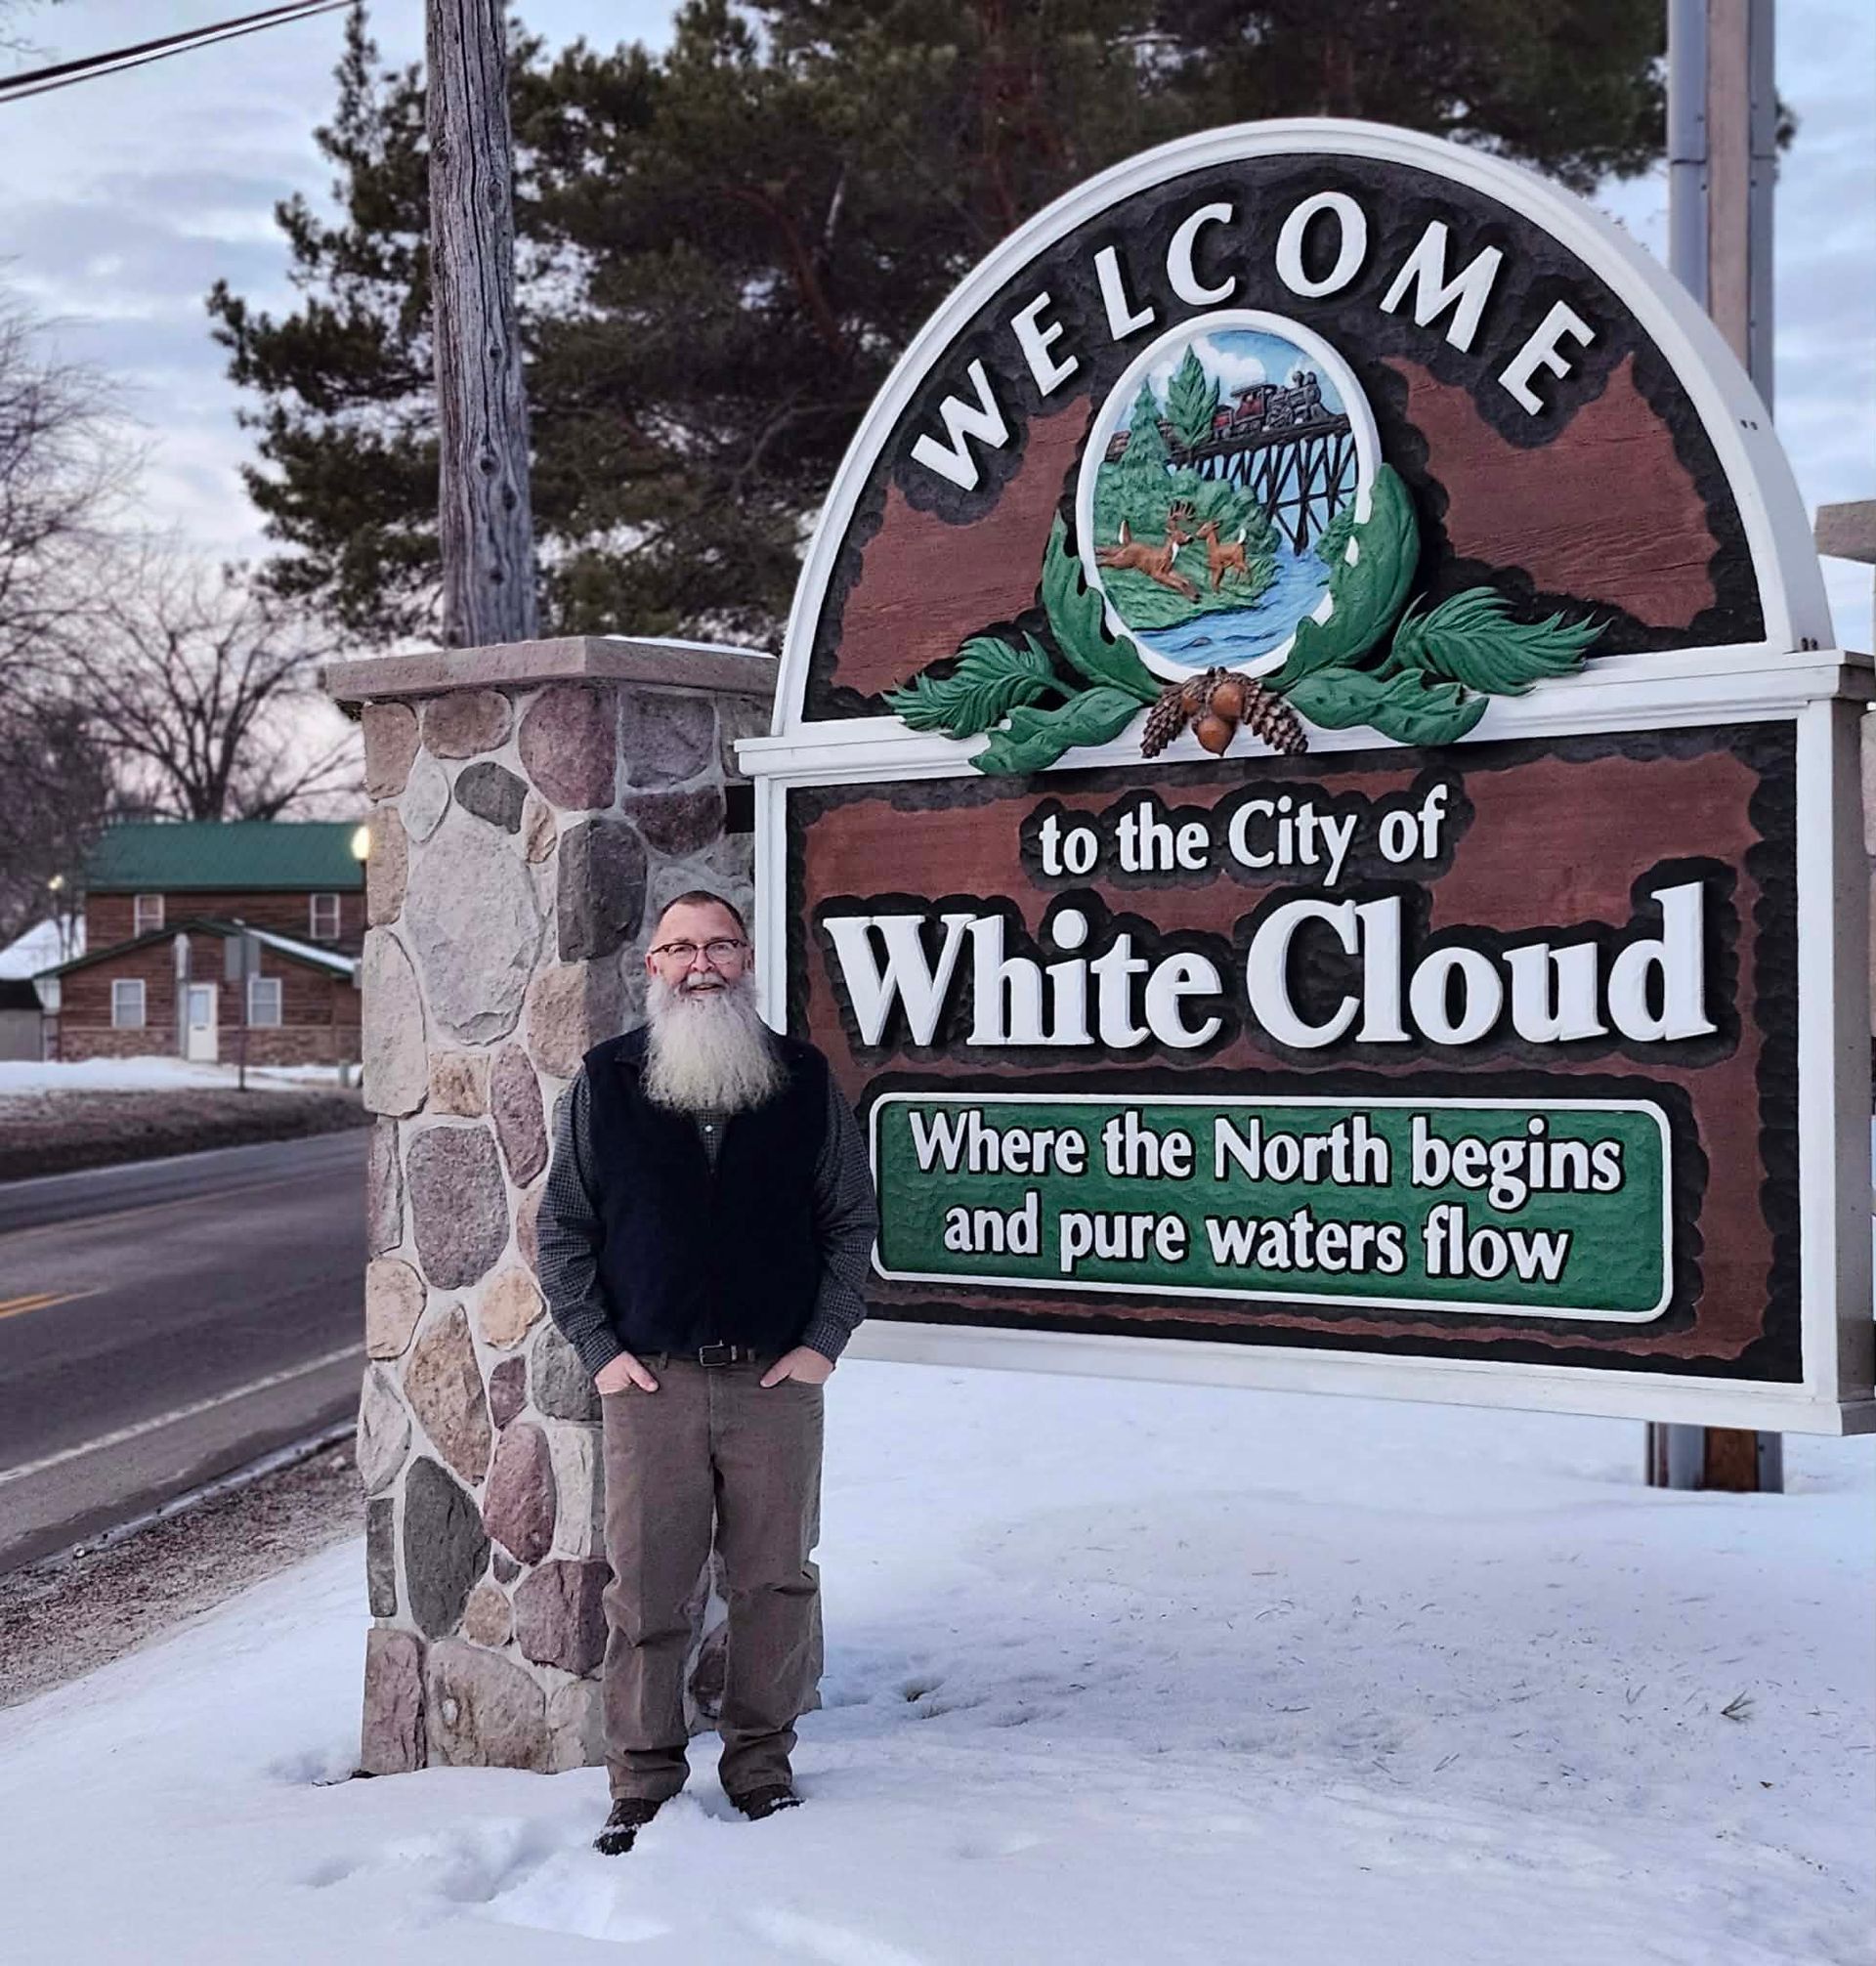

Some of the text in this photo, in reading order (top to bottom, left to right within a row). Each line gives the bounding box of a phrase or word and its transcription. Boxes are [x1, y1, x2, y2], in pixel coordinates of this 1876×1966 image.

[911, 192, 1595, 491] WELCOME
[1040, 785, 1447, 885] to the City of
[823, 881, 1716, 1047] White Cloud
[910, 1111, 1622, 1210] Where the North begins
[945, 1192, 1568, 1280] and pure waters flow
